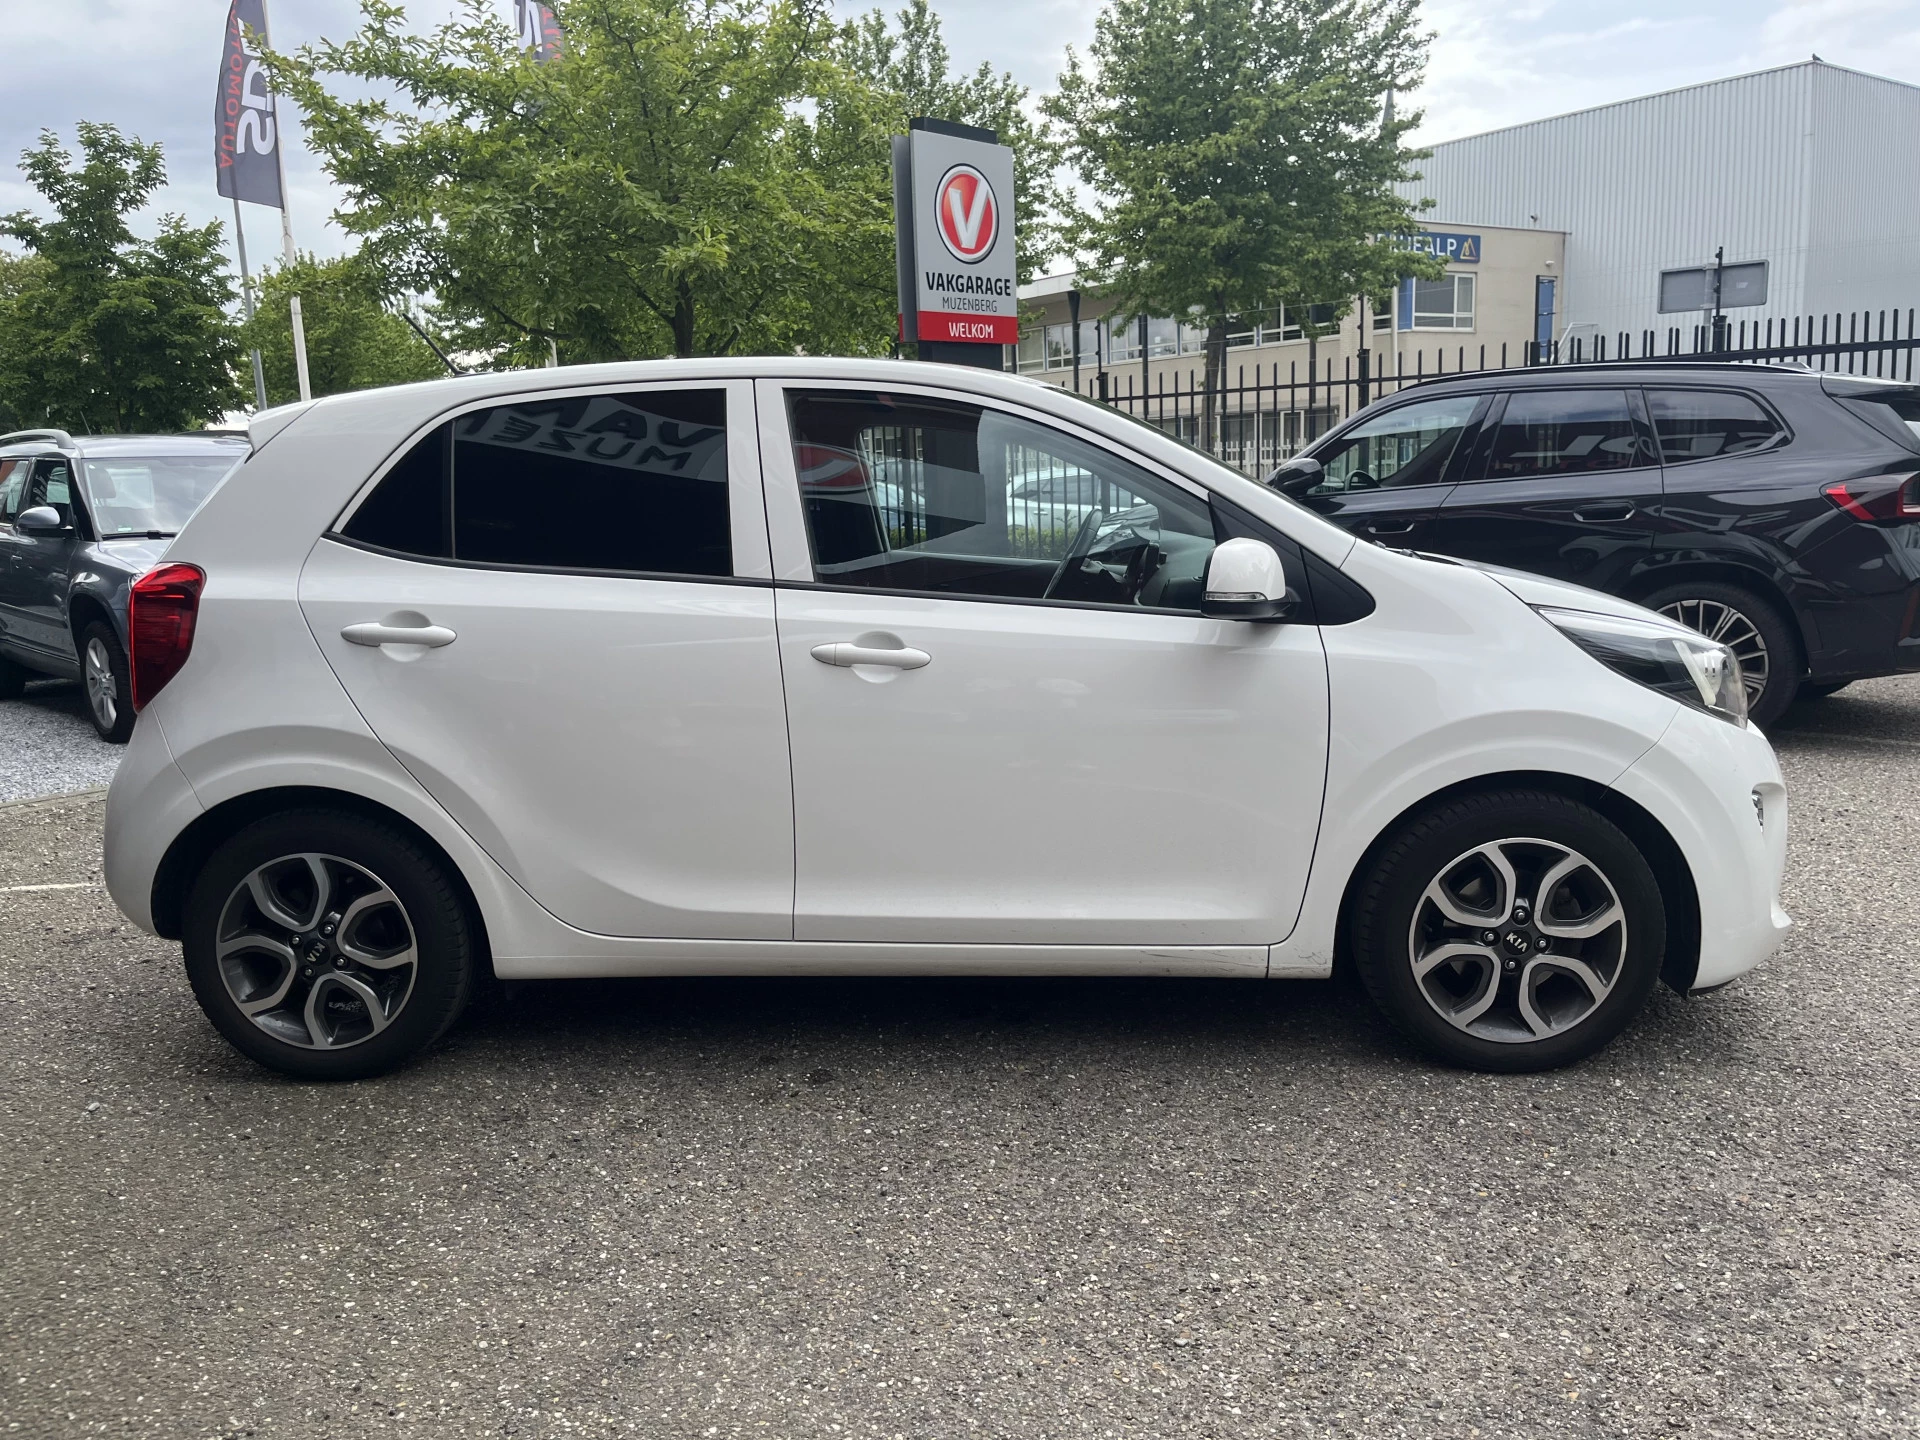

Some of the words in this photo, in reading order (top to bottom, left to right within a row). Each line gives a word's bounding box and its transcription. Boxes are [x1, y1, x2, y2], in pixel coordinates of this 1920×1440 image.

[925, 271, 1011, 297] VAKGARAGE
[942, 296, 998, 313] MUZENBERG
[948, 321, 994, 339] WELKOM
[306, 942, 326, 962] KIA
[1506, 932, 1528, 952] KIA
